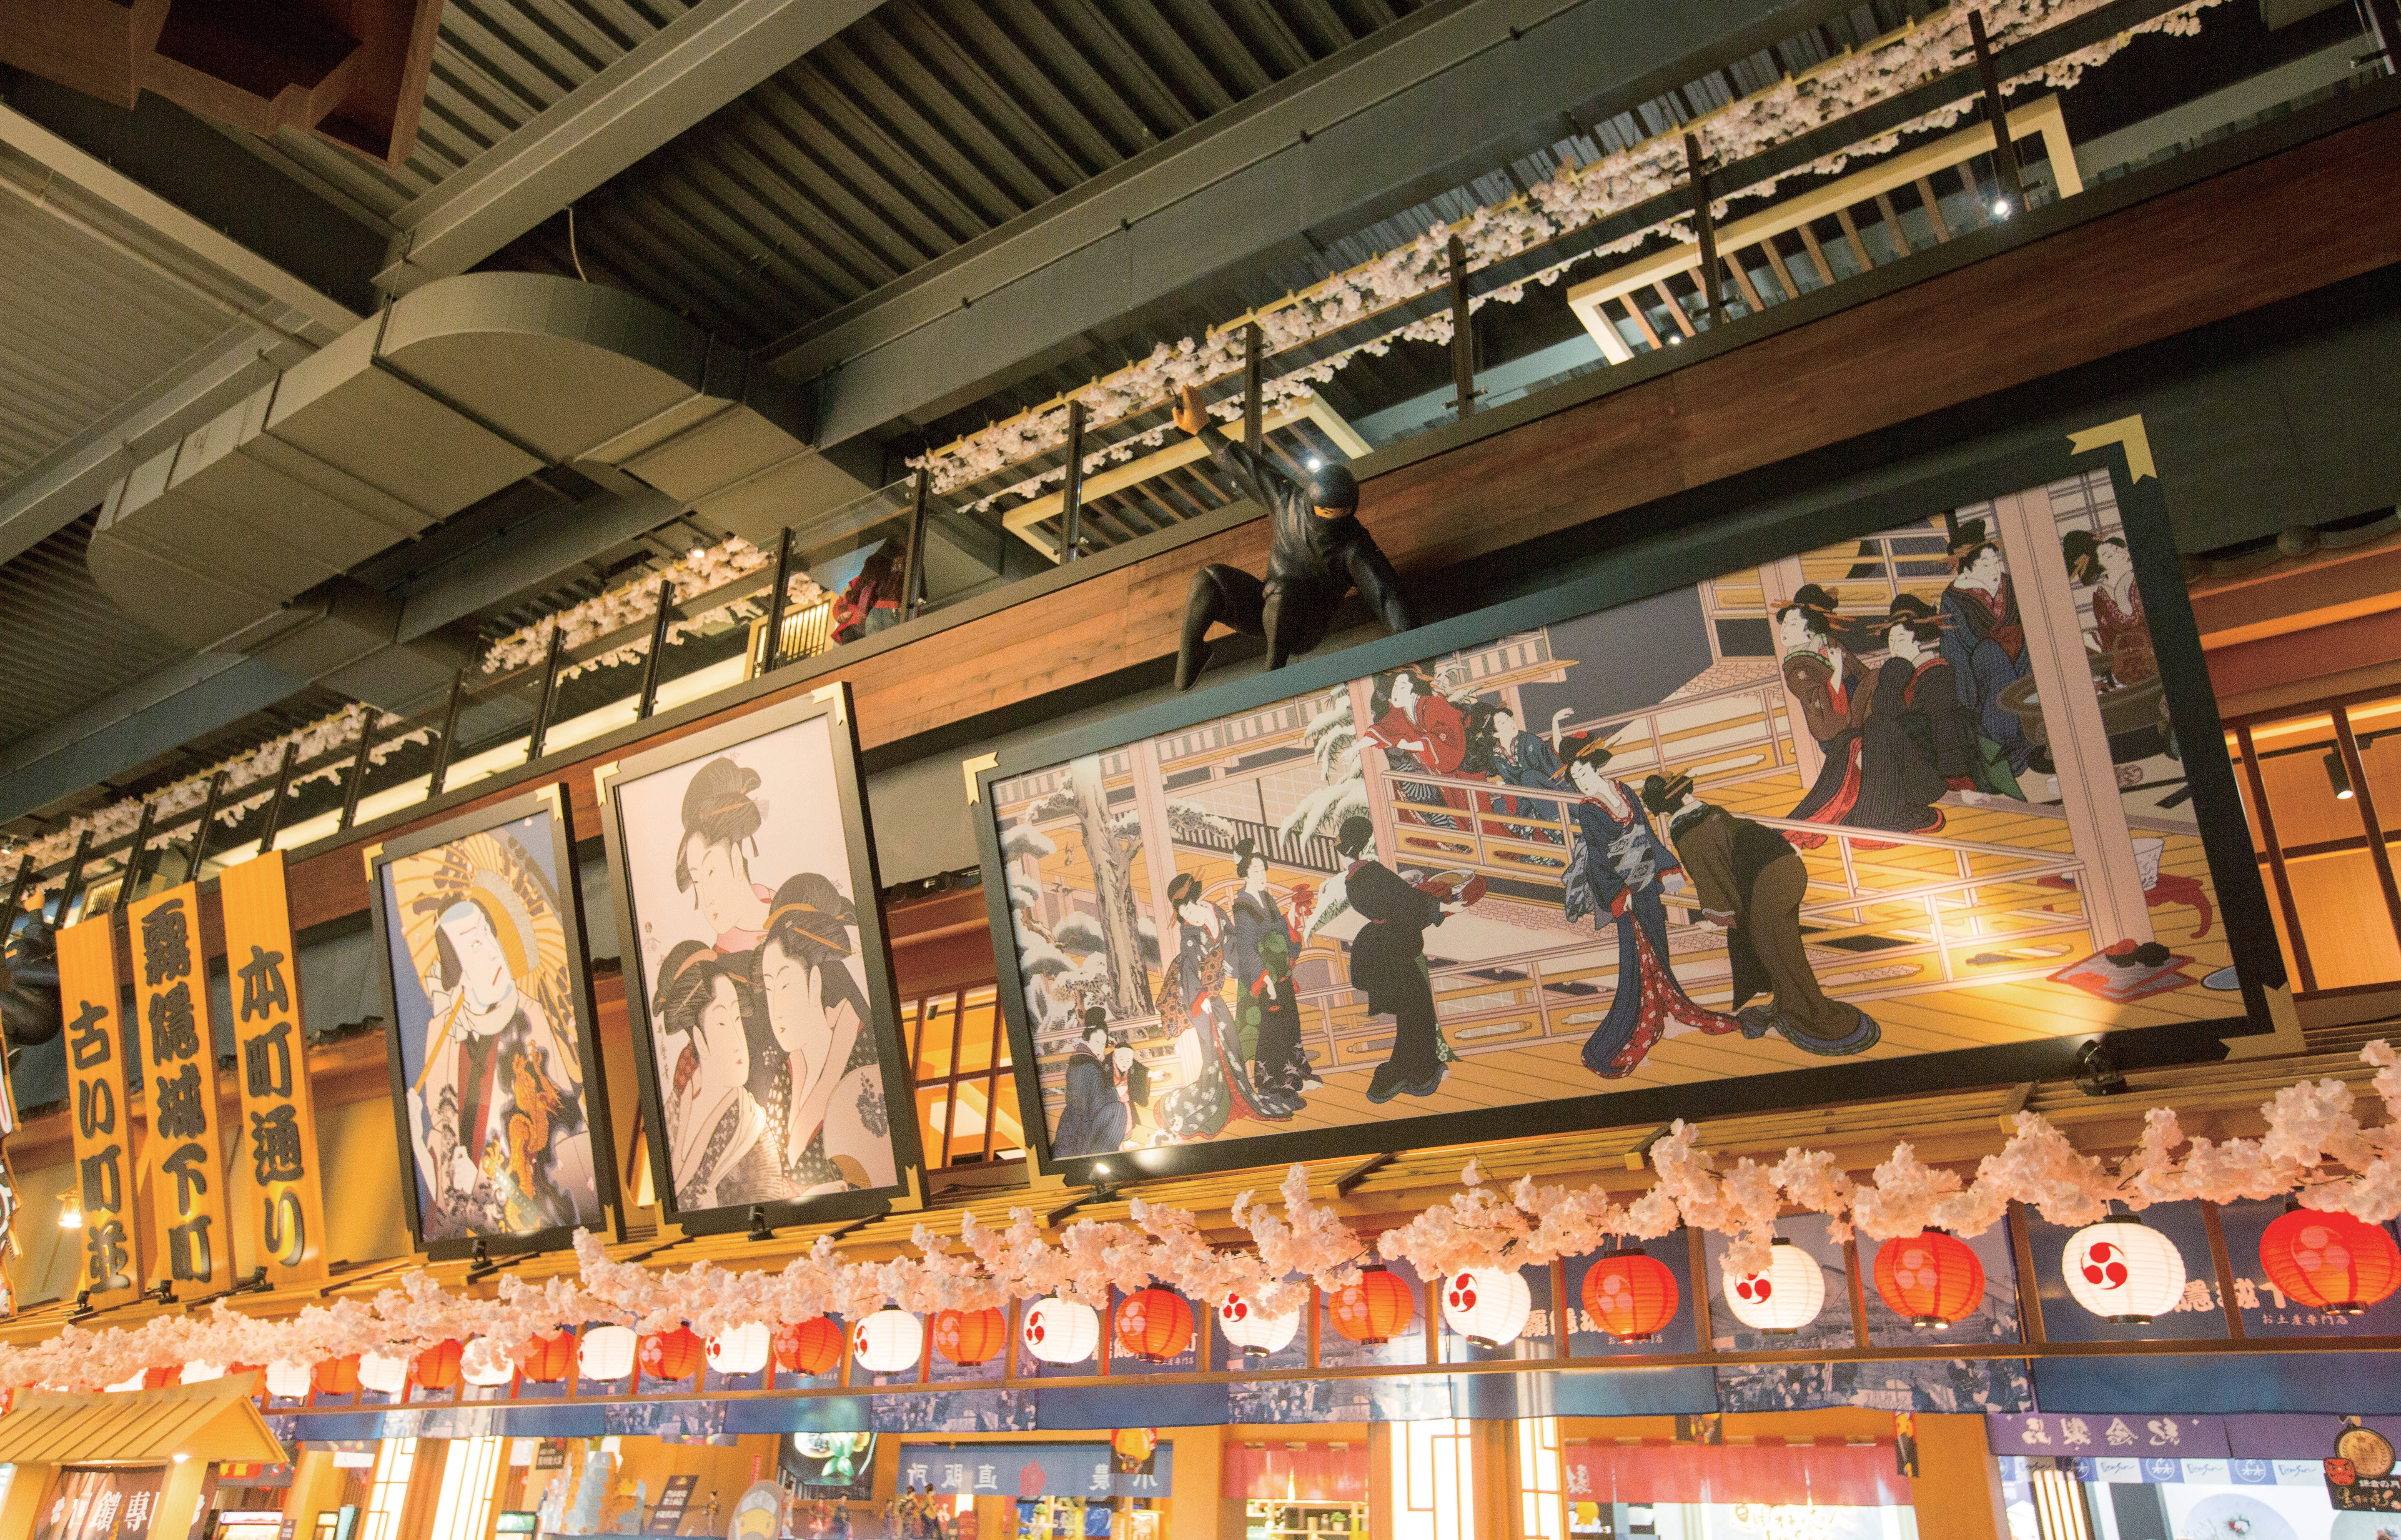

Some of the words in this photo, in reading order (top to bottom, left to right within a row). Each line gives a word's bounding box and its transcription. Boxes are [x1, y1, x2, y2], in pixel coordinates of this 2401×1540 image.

[69, 1000, 131, 1293] 古い町並
[238, 945, 305, 1267] 本町通り
